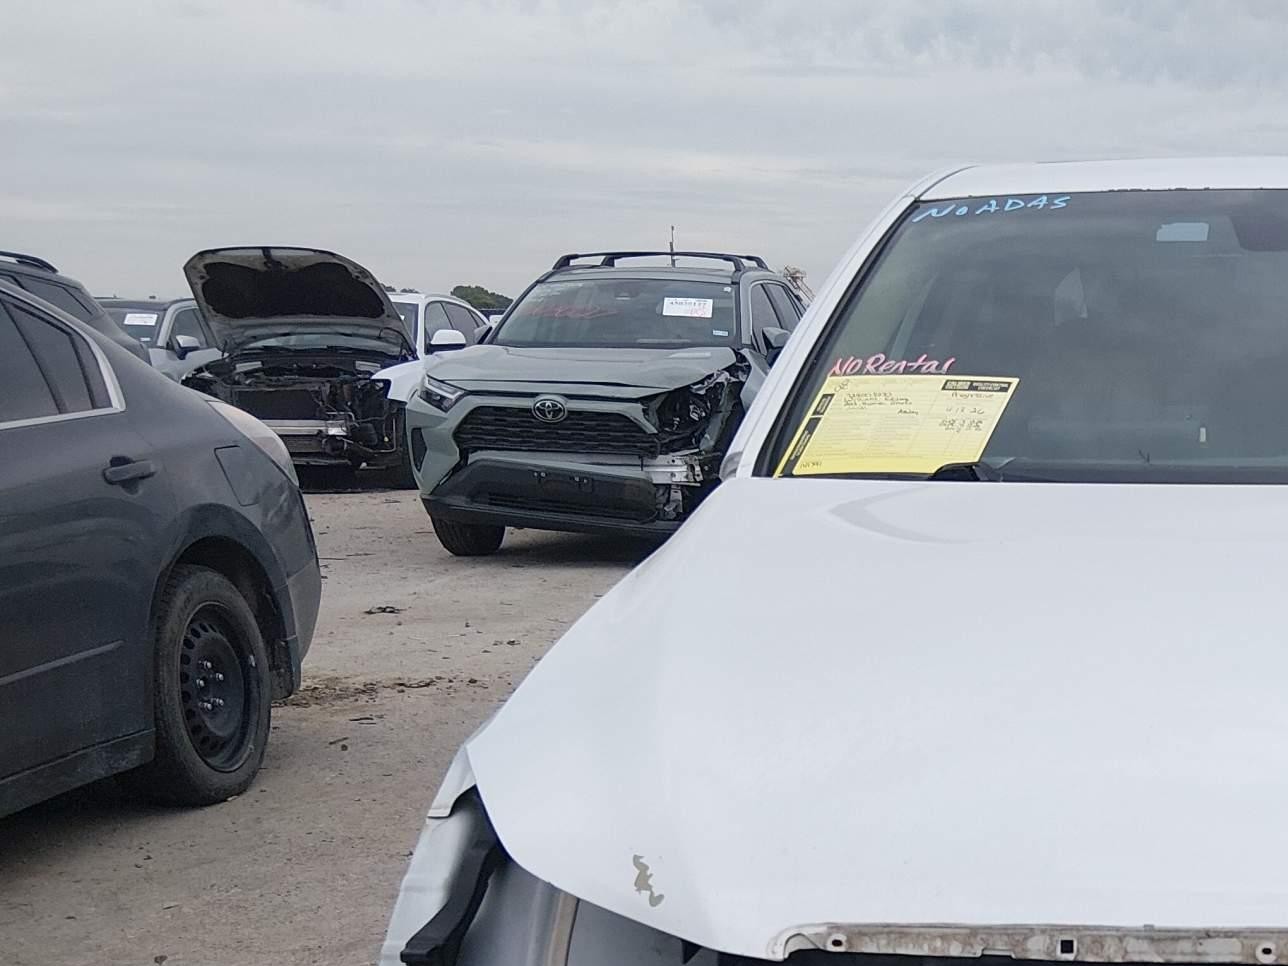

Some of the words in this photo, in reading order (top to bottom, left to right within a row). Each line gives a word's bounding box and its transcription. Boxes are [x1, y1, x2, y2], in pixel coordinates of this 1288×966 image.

[912, 203, 969, 223] NO
[975, 195, 1071, 215] ADAS
[863, 353, 955, 375] Rental
